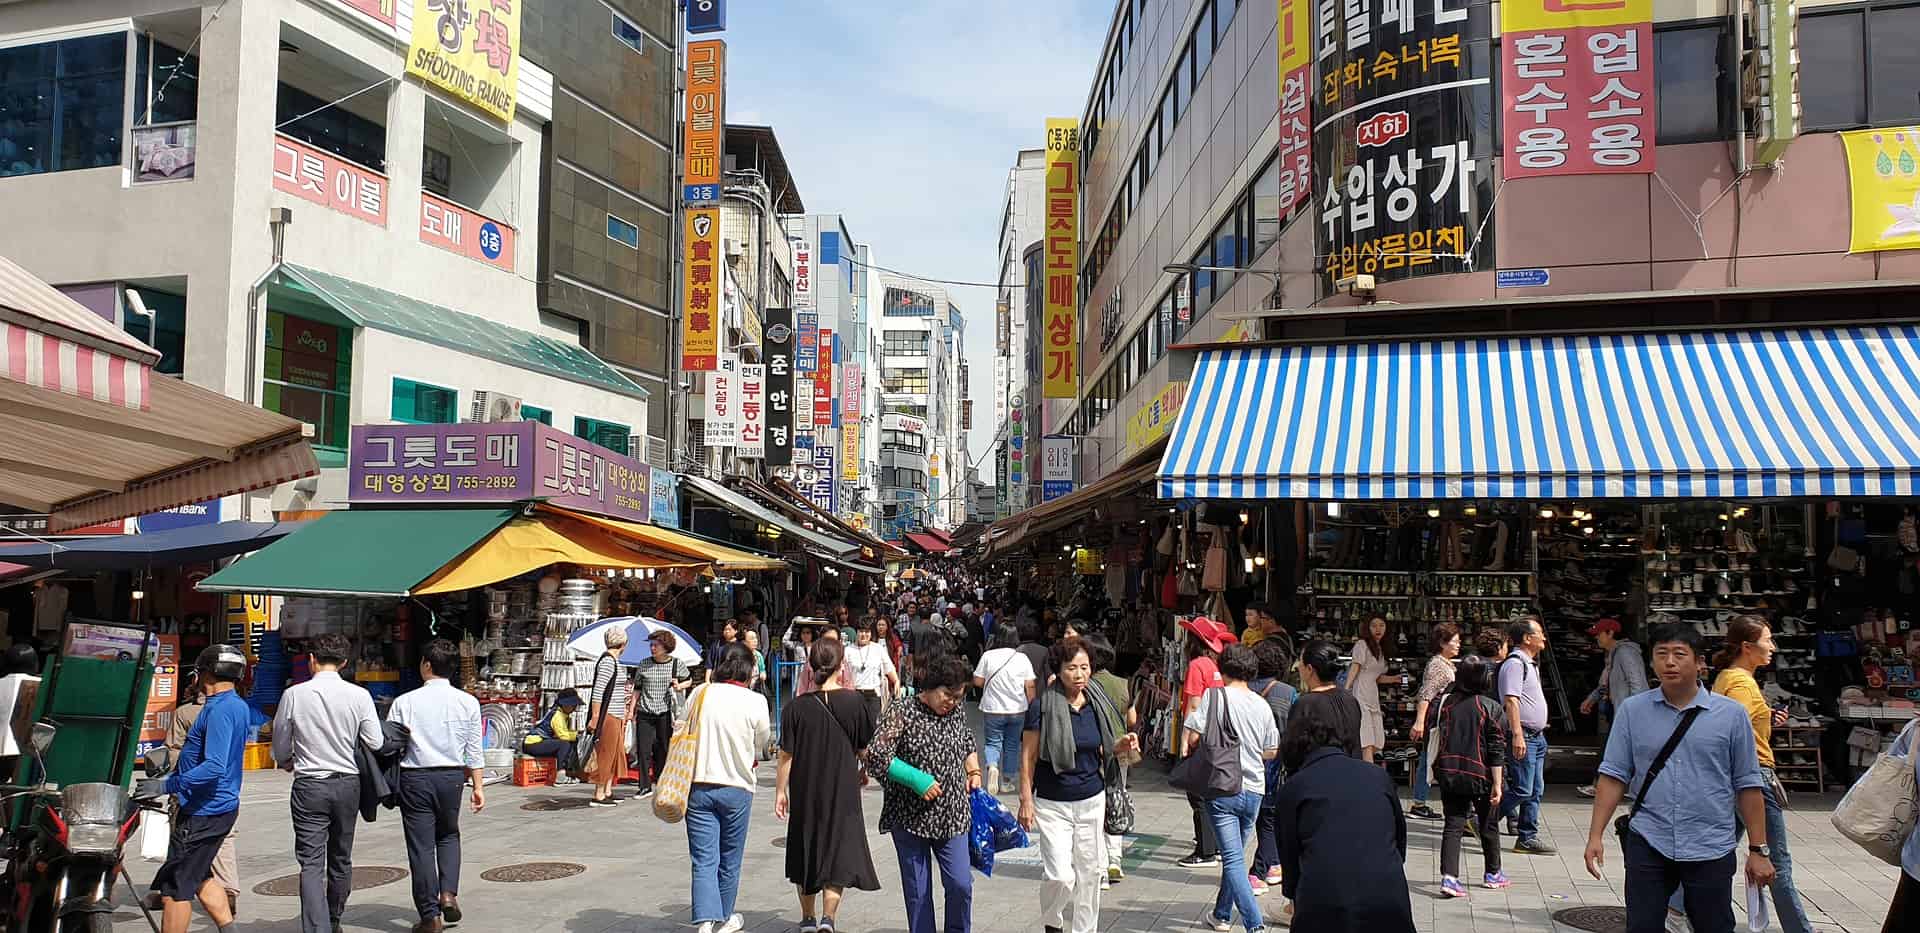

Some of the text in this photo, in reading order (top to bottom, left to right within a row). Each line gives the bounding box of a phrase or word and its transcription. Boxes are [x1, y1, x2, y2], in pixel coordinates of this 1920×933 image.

[414, 48, 512, 113] SHOOTING RANGE
[1514, 34, 1569, 168] 혼수용
[1587, 29, 1644, 167] 업소용
[690, 47, 715, 177] 그릇 이불 도매
[1362, 117, 1402, 141] 지하
[273, 144, 382, 216] 그릇 이불
[692, 187, 713, 200] 3층
[1322, 140, 1476, 242] 수입상가
[421, 201, 500, 252] 도매 3층
[1326, 225, 1465, 284] 수입상품일체
[690, 240, 712, 334] 實彈射擊
[796, 252, 809, 292] 부동산
[1047, 162, 1074, 383] 그릇도매상가
[693, 359, 706, 369] 4F
[715, 377, 727, 416] 컨설팅
[742, 382, 761, 442] 부동산
[769, 354, 789, 447] 준안경
[364, 434, 519, 468] 그릇도매
[544, 437, 605, 503] 그릇도매
[608, 462, 647, 494] 대영상회
[364, 474, 516, 493] 대영상회 755-2892
[615, 495, 641, 511] 755-2892
